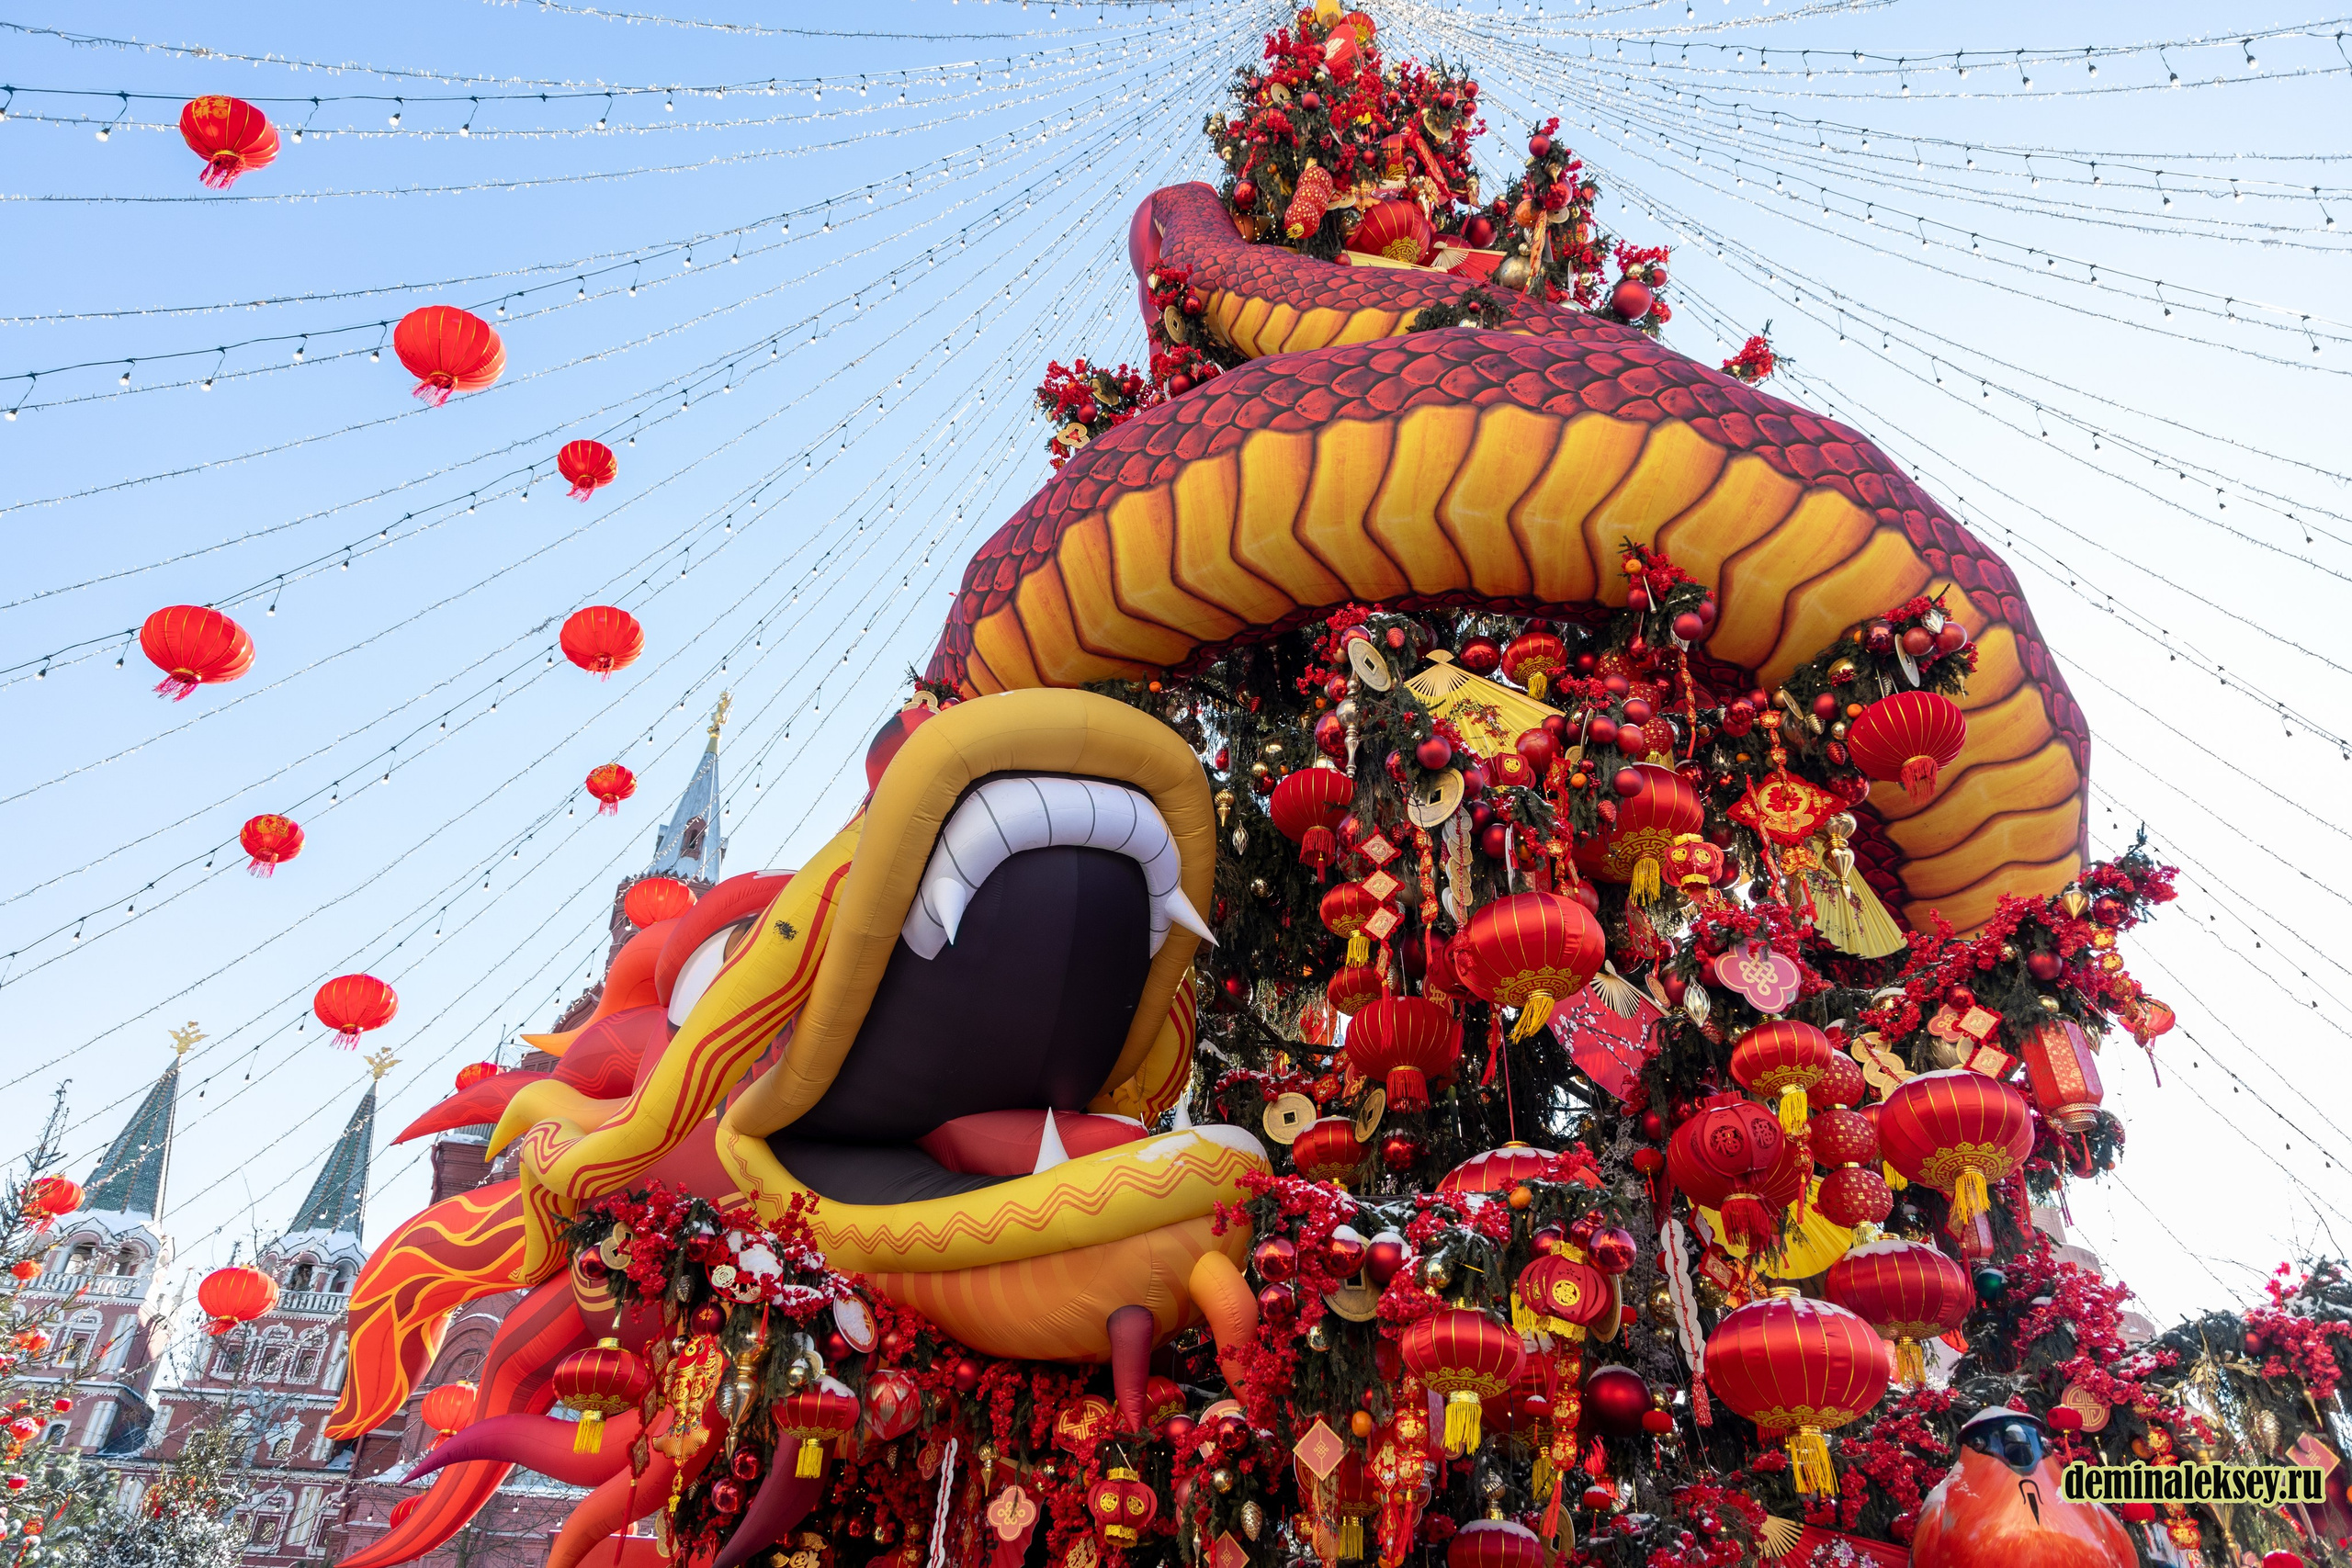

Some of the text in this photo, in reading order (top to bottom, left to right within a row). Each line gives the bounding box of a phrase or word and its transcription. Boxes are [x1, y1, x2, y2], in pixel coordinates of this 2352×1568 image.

[1715, 1128, 1741, 1155] 福
[1753, 1121, 1775, 1146] 福
[672, 1376, 690, 1401] 福
[691, 1374, 704, 1399] 福
